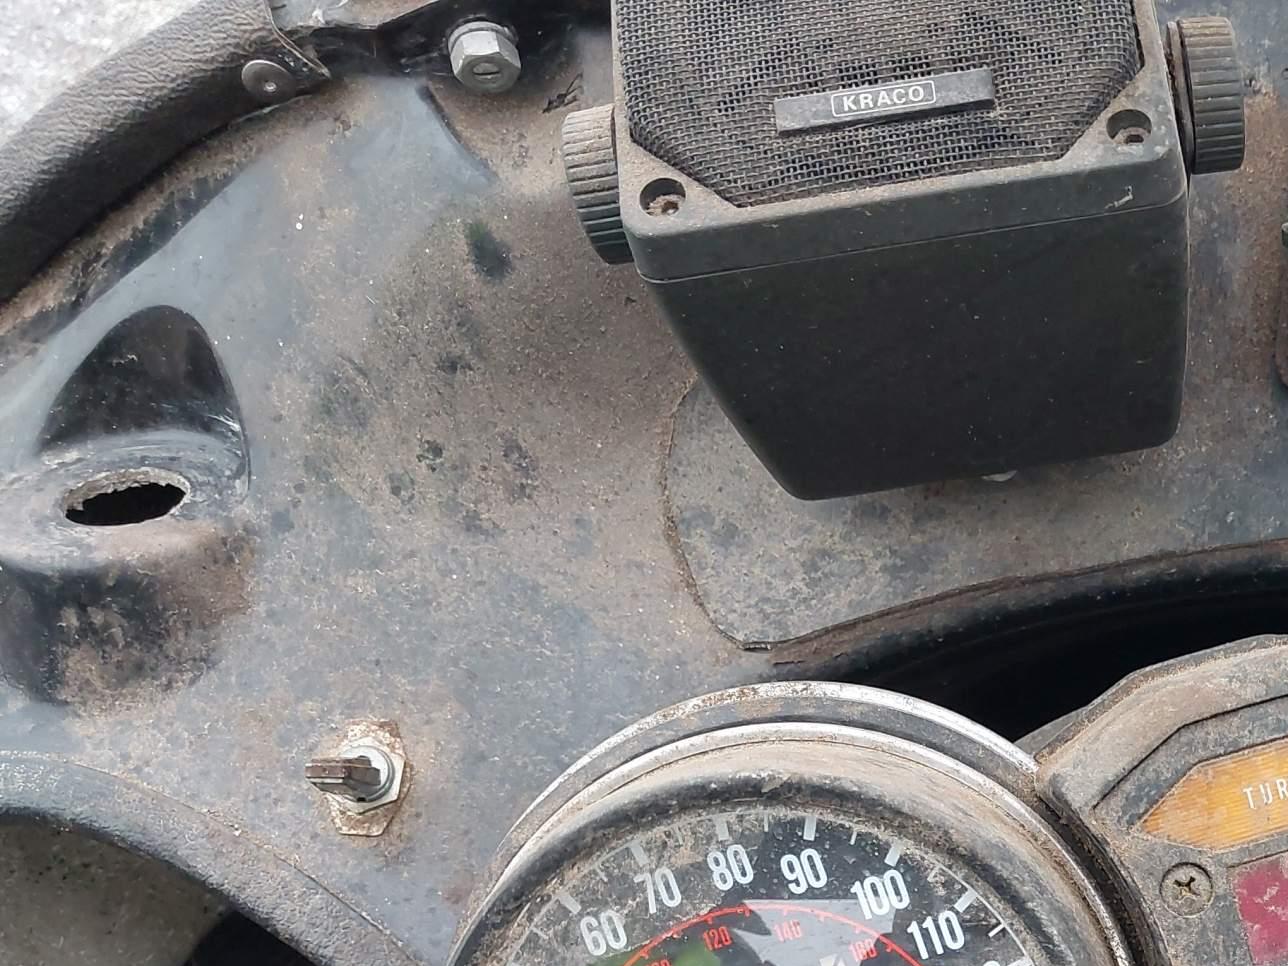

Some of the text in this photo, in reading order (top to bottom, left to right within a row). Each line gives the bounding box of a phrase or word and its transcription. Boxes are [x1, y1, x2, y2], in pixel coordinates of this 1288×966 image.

[843, 85, 925, 112] KRACO
[633, 867, 682, 914] 70
[707, 844, 753, 891] 80
[781, 848, 828, 894] 90
[851, 869, 911, 919] 100
[580, 910, 628, 956] 60
[704, 926, 732, 951] 120
[774, 918, 802, 943] 140
[907, 910, 965, 960] 110
